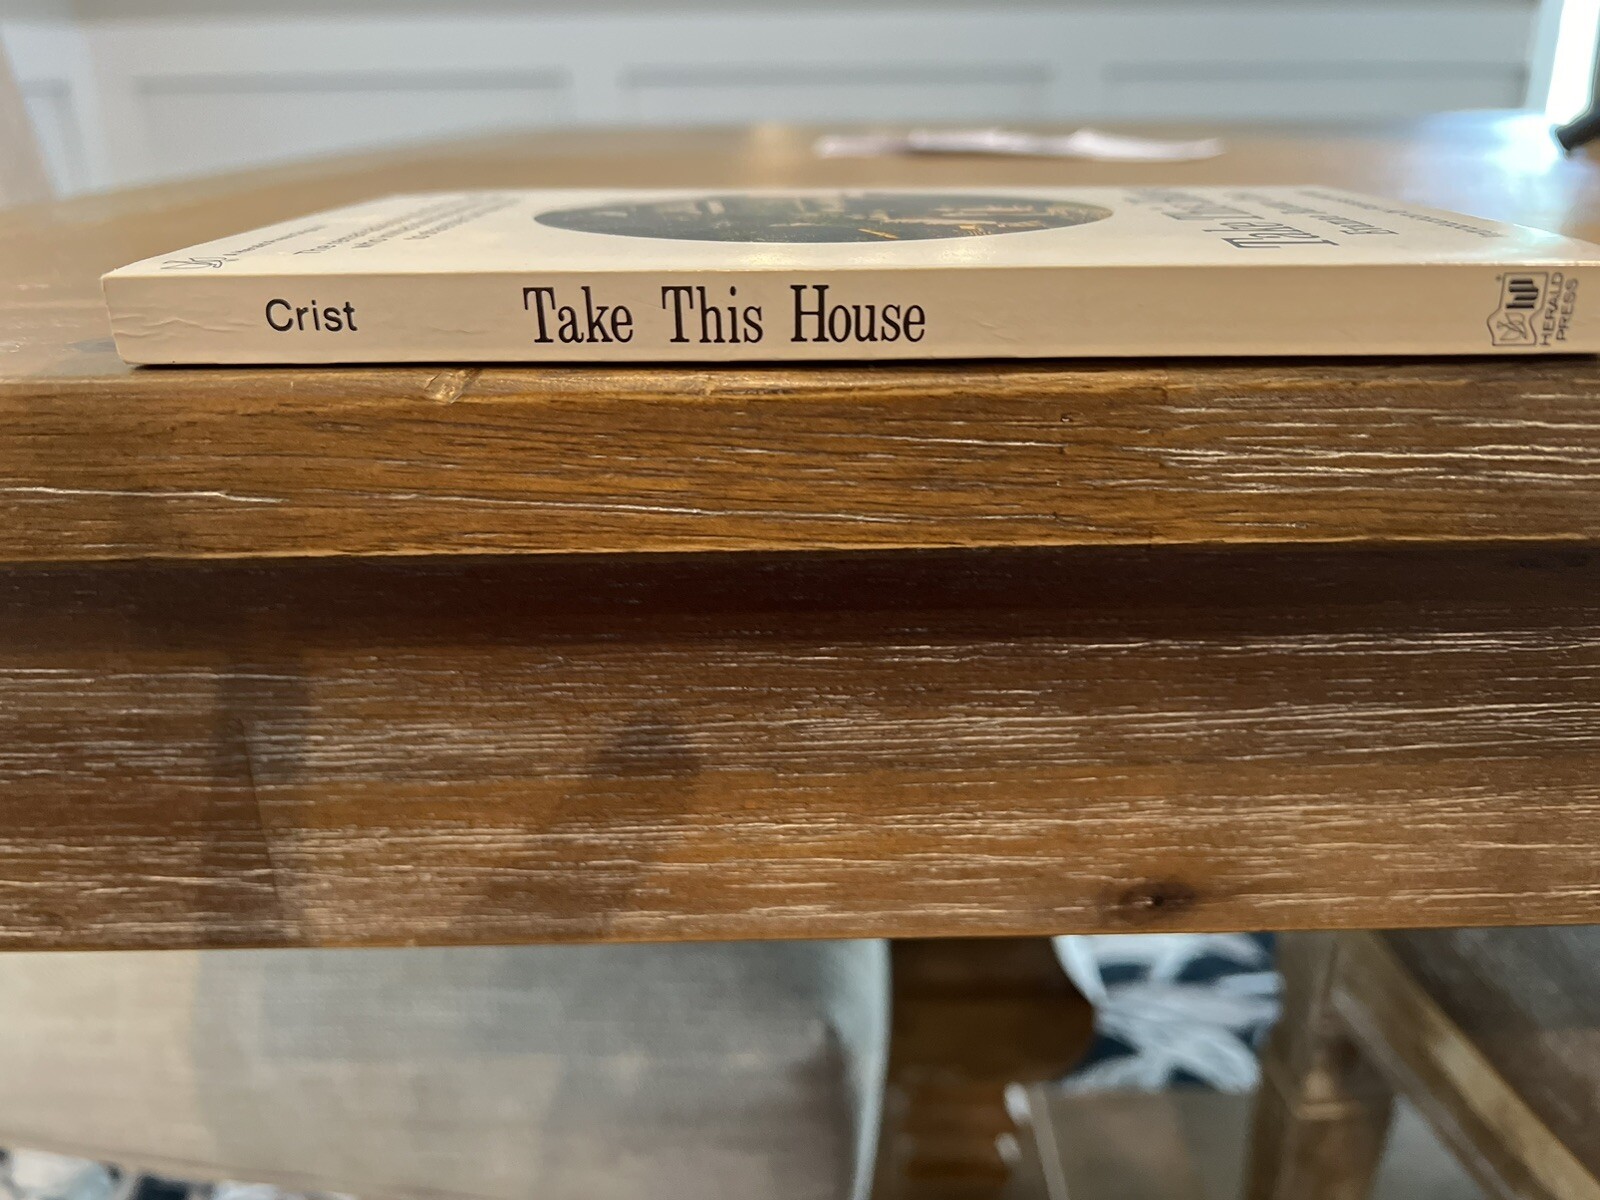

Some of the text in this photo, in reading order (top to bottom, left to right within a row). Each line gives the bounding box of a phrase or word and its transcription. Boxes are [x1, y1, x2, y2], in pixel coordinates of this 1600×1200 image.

[265, 298, 358, 332] Crist
[522, 284, 926, 344] Take This House
[1539, 272, 1563, 346] HERALD
[1555, 278, 1578, 341] PRESS
